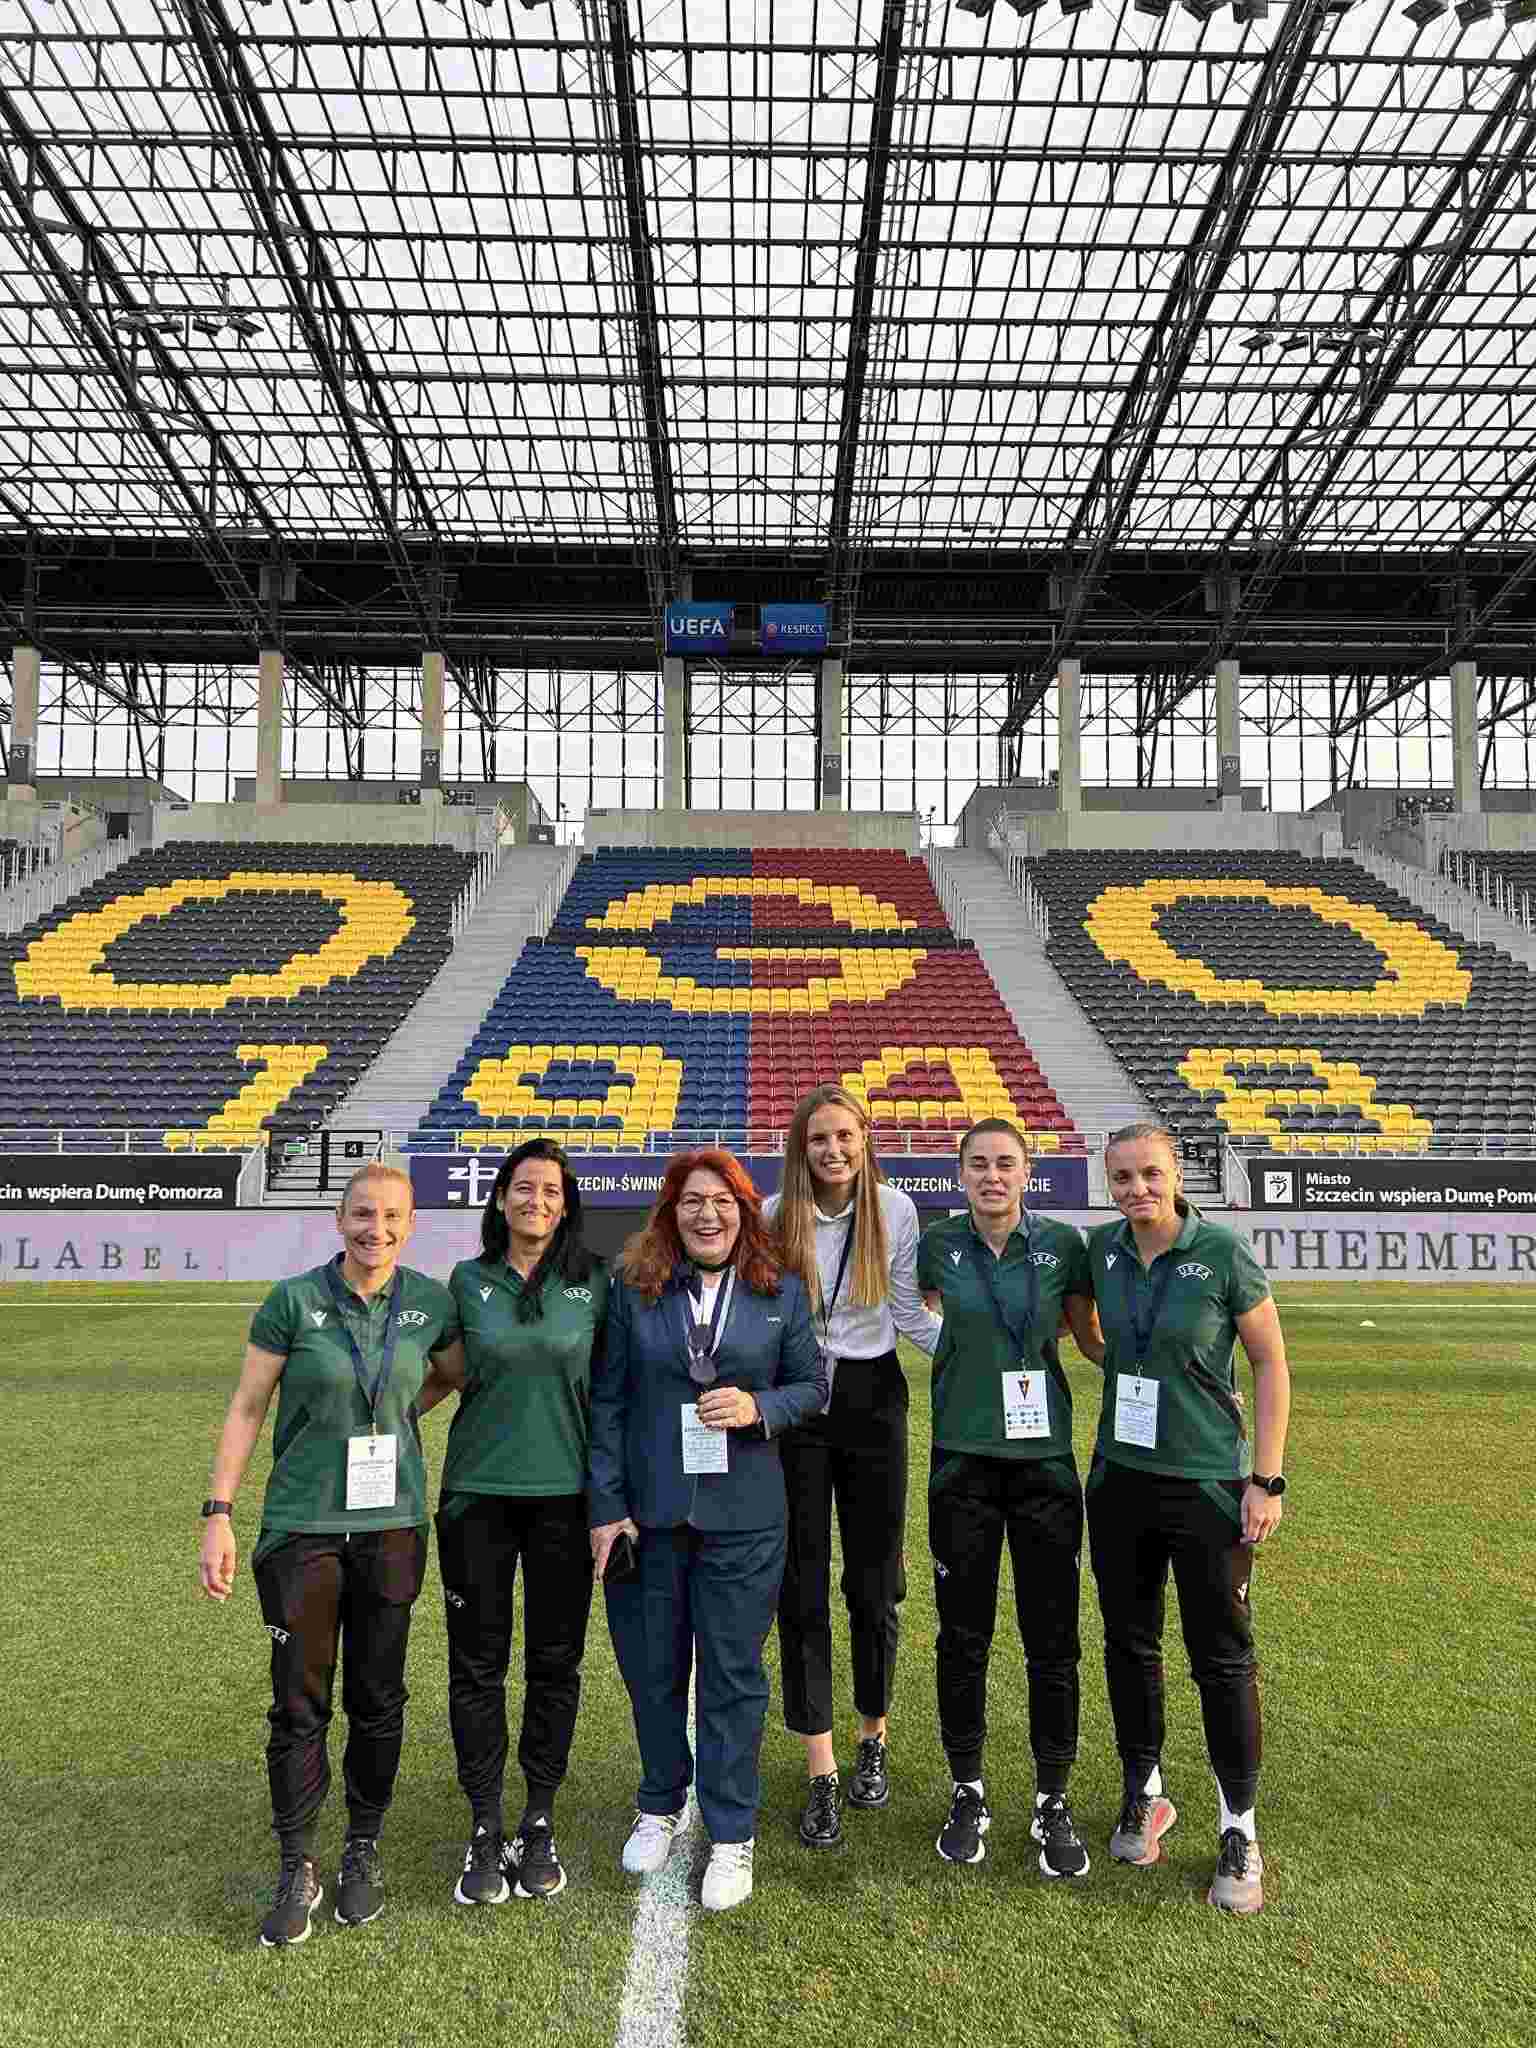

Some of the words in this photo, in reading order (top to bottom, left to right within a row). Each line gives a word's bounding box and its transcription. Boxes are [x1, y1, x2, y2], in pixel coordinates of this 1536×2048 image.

[671, 618, 725, 634] UEFA
[781, 624, 825, 634] RESPECT
[348, 1143, 358, 1154] 4
[1188, 1146, 1198, 1158] 5
[1306, 1172, 1351, 1186] Miasto
[27, 1183, 93, 1204] wspiera
[95, 1184, 145, 1204] Dumę
[149, 1184, 223, 1200] Pomorza
[1306, 1187, 1375, 1203] Szczecin
[1380, 1188, 1442, 1206] wspiera
[1445, 1188, 1494, 1207] Dumę
[1497, 1188, 1536, 1204] Pom
[1178, 1263, 1212, 1281] UEFA
